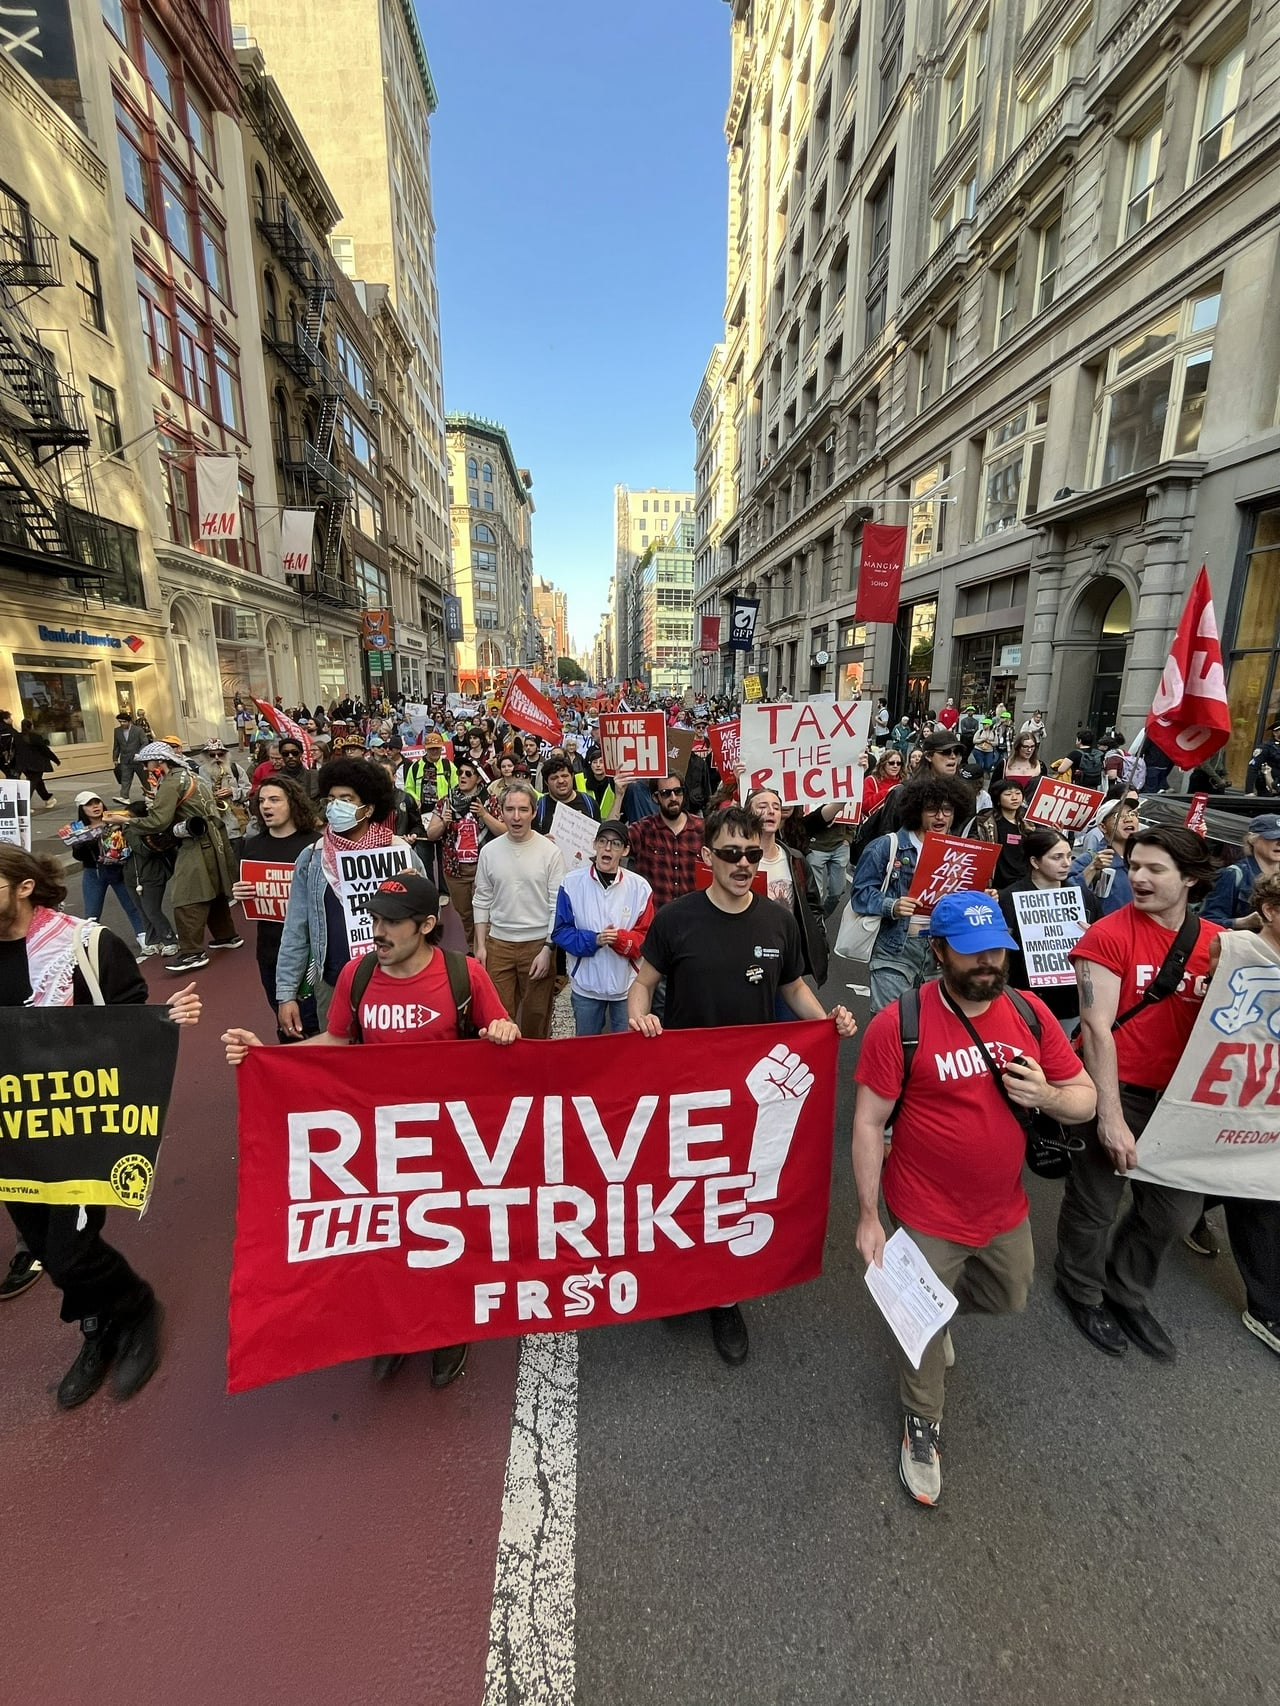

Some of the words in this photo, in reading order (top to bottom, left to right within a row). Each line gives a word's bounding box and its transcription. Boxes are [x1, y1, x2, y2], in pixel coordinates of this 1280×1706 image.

[202, 513, 235, 535] H&M
[283, 552, 308, 571] H&M
[38, 625, 68, 642] Bank
[69, 630, 80, 644] of
[81, 631, 121, 648] America
[733, 629, 753, 639] GFP
[605, 720, 619, 735] TAX
[622, 719, 646, 735] THE
[757, 704, 858, 744] TAX
[720, 729, 737, 740] WE
[722, 737, 741, 748] ARE
[603, 735, 659, 771] RICH
[722, 749, 741, 760] THE
[772, 744, 831, 768] THE
[750, 766, 854, 802] RICH
[1053, 785, 1074, 800] TAX
[1074, 791, 1092, 804] THE
[1032, 793, 1093, 828] RICH
[341, 850, 408, 881] DOWN
[943, 847, 978, 866] WE
[933, 862, 978, 880] ARE
[930, 874, 974, 893] THE
[253, 897, 277, 916] TAX
[347, 892, 377, 916] TR
[1019, 893, 1050, 909] FIGHT
[1053, 890, 1077, 906] FOR
[358, 916, 371, 926] &
[969, 914, 993, 927] UFT
[1020, 906, 1081, 925] WORKERS'
[1043, 925, 1064, 938] AND
[351, 944, 378, 958] FRS
[1032, 951, 1071, 973] RIGH
[1031, 975, 1058, 985] FRSO
[363, 1003, 417, 1030] MORE
[0, 1067, 119, 1104] ATION
[0, 1104, 159, 1140] VENTION
[287, 1089, 732, 1200] REVIVE
[1215, 1129, 1280, 1145] FREEDOM
[121, 1191, 145, 1201] WAR
[294, 1200, 395, 1252] THE
[474, 1268, 638, 1325] FRSO
